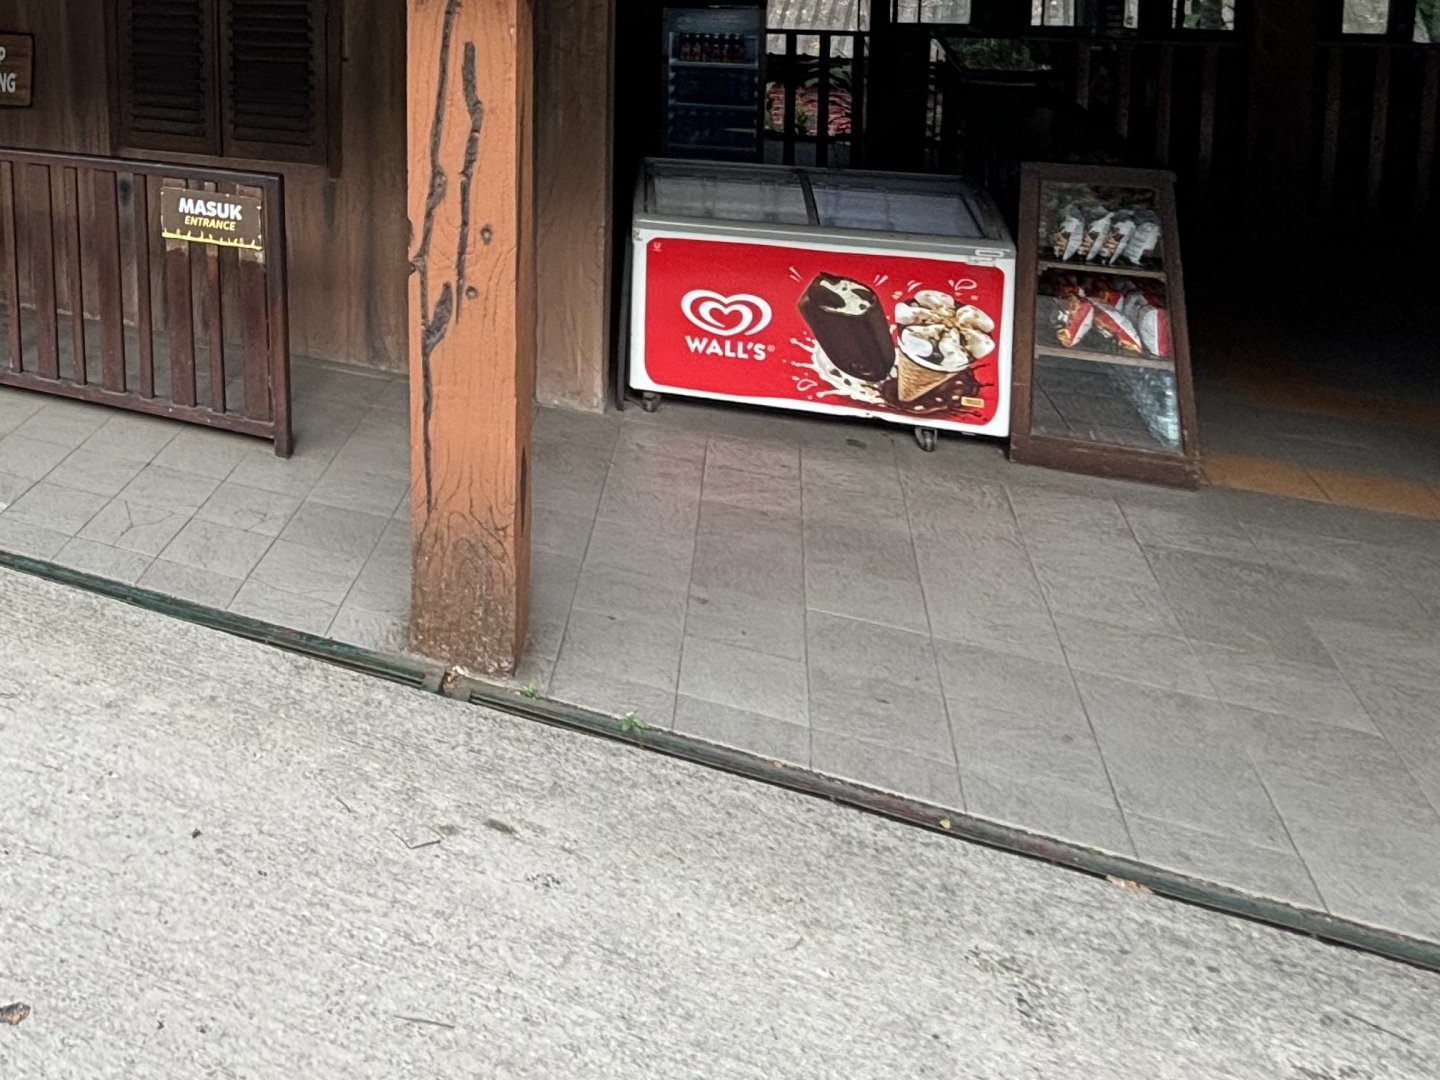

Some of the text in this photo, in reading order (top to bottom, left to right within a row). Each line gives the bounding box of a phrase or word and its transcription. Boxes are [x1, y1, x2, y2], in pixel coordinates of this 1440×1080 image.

[178, 198, 242, 220] MASUK
[184, 216, 236, 231] ENTRANCE
[684, 334, 766, 361] WALL'S
